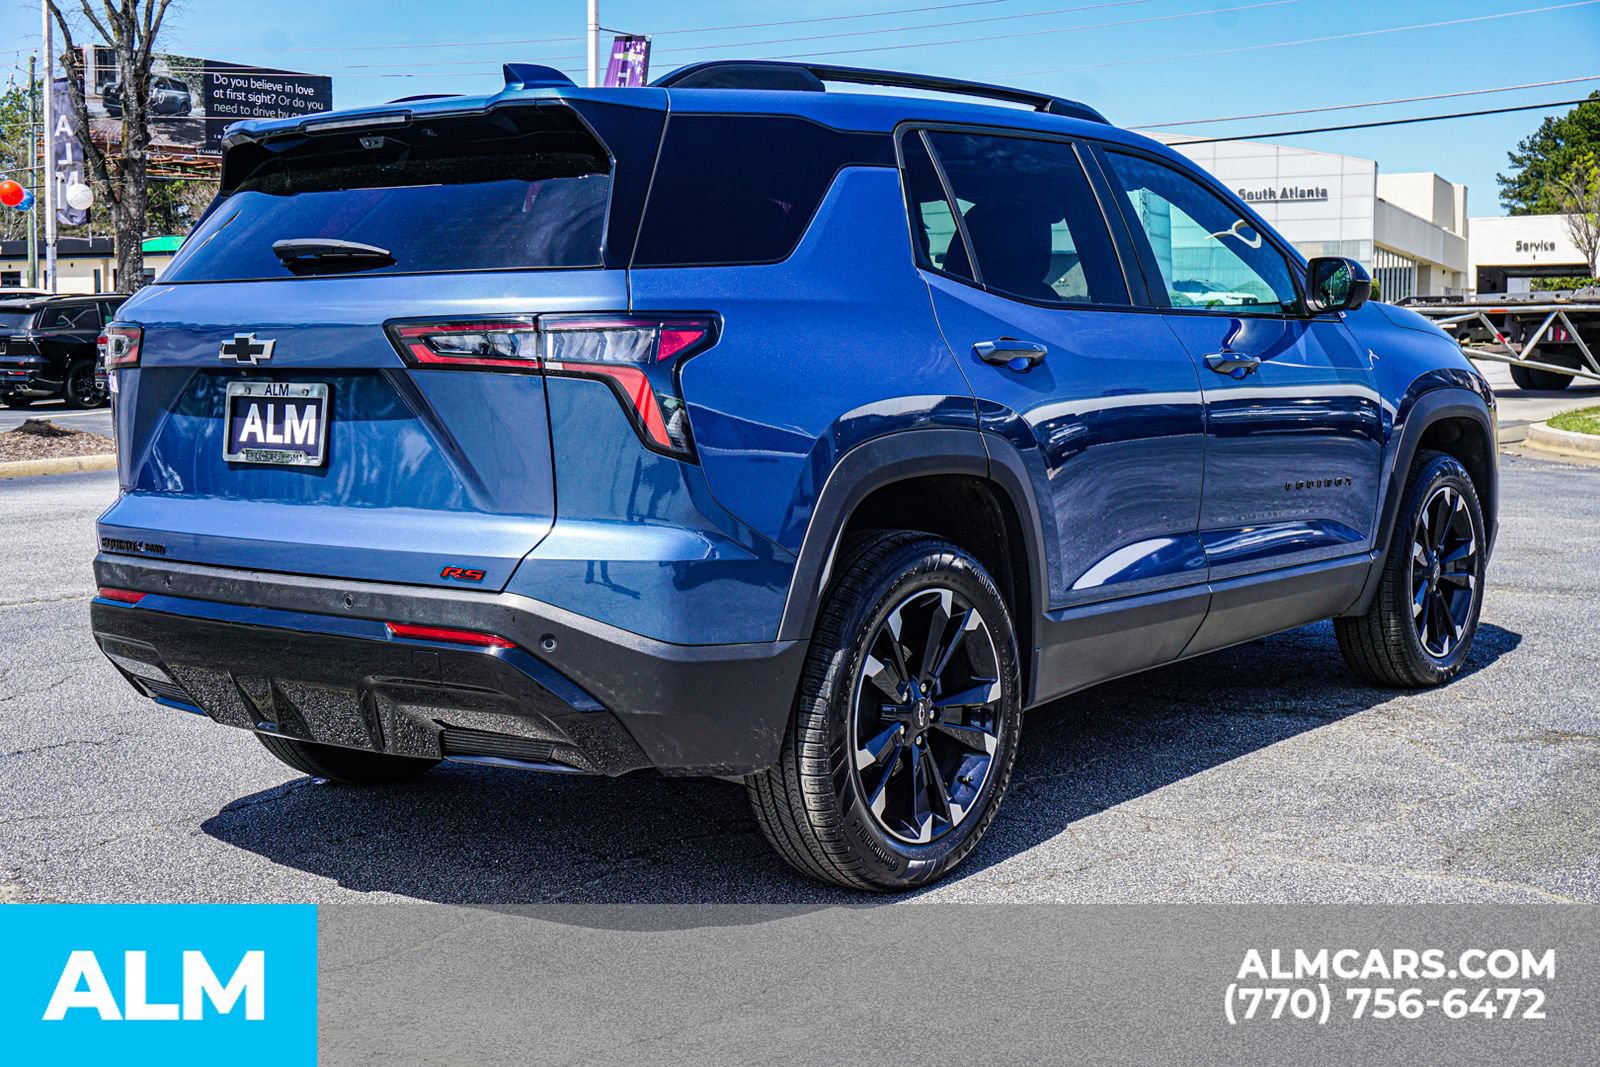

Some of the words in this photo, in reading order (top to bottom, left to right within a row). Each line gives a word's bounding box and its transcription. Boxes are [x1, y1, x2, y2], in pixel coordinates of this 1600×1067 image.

[213, 73, 228, 85] Do
[230, 78, 248, 88] you
[250, 78, 283, 92] believe
[285, 82, 293, 94] in
[295, 84, 314, 96] love
[213, 89, 224, 98] at
[226, 89, 246, 101] first
[248, 92, 276, 105] sight?
[278, 95, 291, 105] Or
[292, 98, 304, 108] do
[307, 101, 324, 111] you
[214, 103, 238, 113] need
[240, 104, 250, 115] to
[253, 107, 275, 117] drive
[1238, 187, 1277, 200] South
[1280, 186, 1327, 199] Atlanta
[1516, 240, 1555, 252] Service
[264, 383, 289, 396] ALM
[239, 403, 316, 445] ALM
[440, 567, 486, 581] RS
